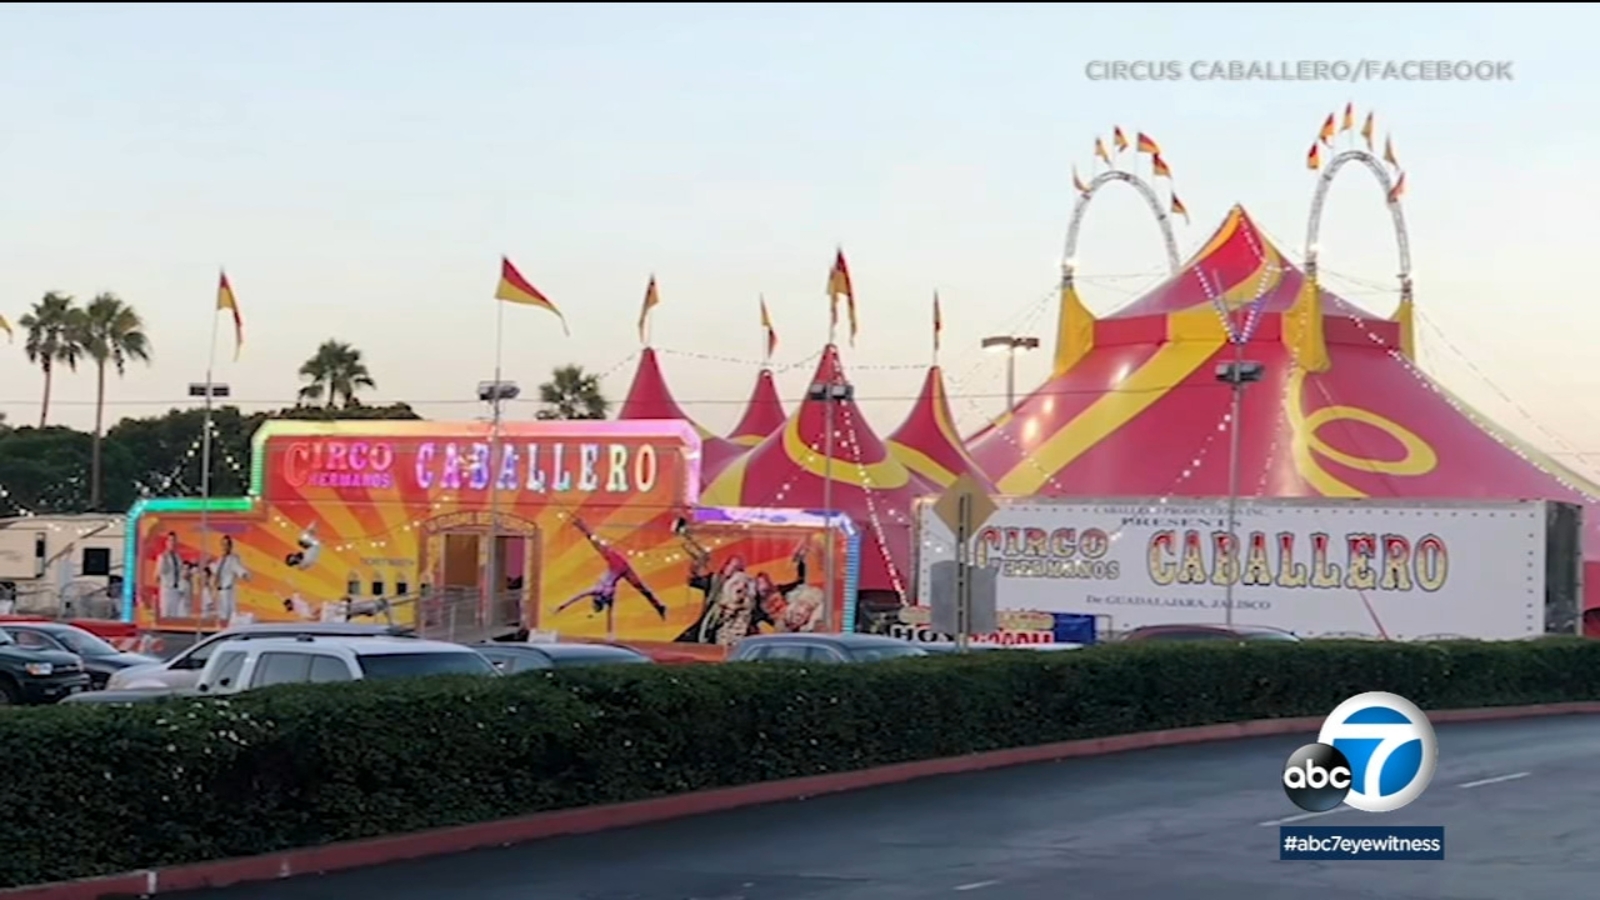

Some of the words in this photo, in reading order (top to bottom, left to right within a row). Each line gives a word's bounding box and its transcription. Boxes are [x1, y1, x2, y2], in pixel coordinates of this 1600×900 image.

[284, 441, 393, 487] CIRCO
[415, 442, 657, 493] CABALLERO
[1121, 516, 1242, 529] PRESENTS
[974, 525, 1109, 571] CIRCO
[1147, 529, 1449, 592] CABALLERO
